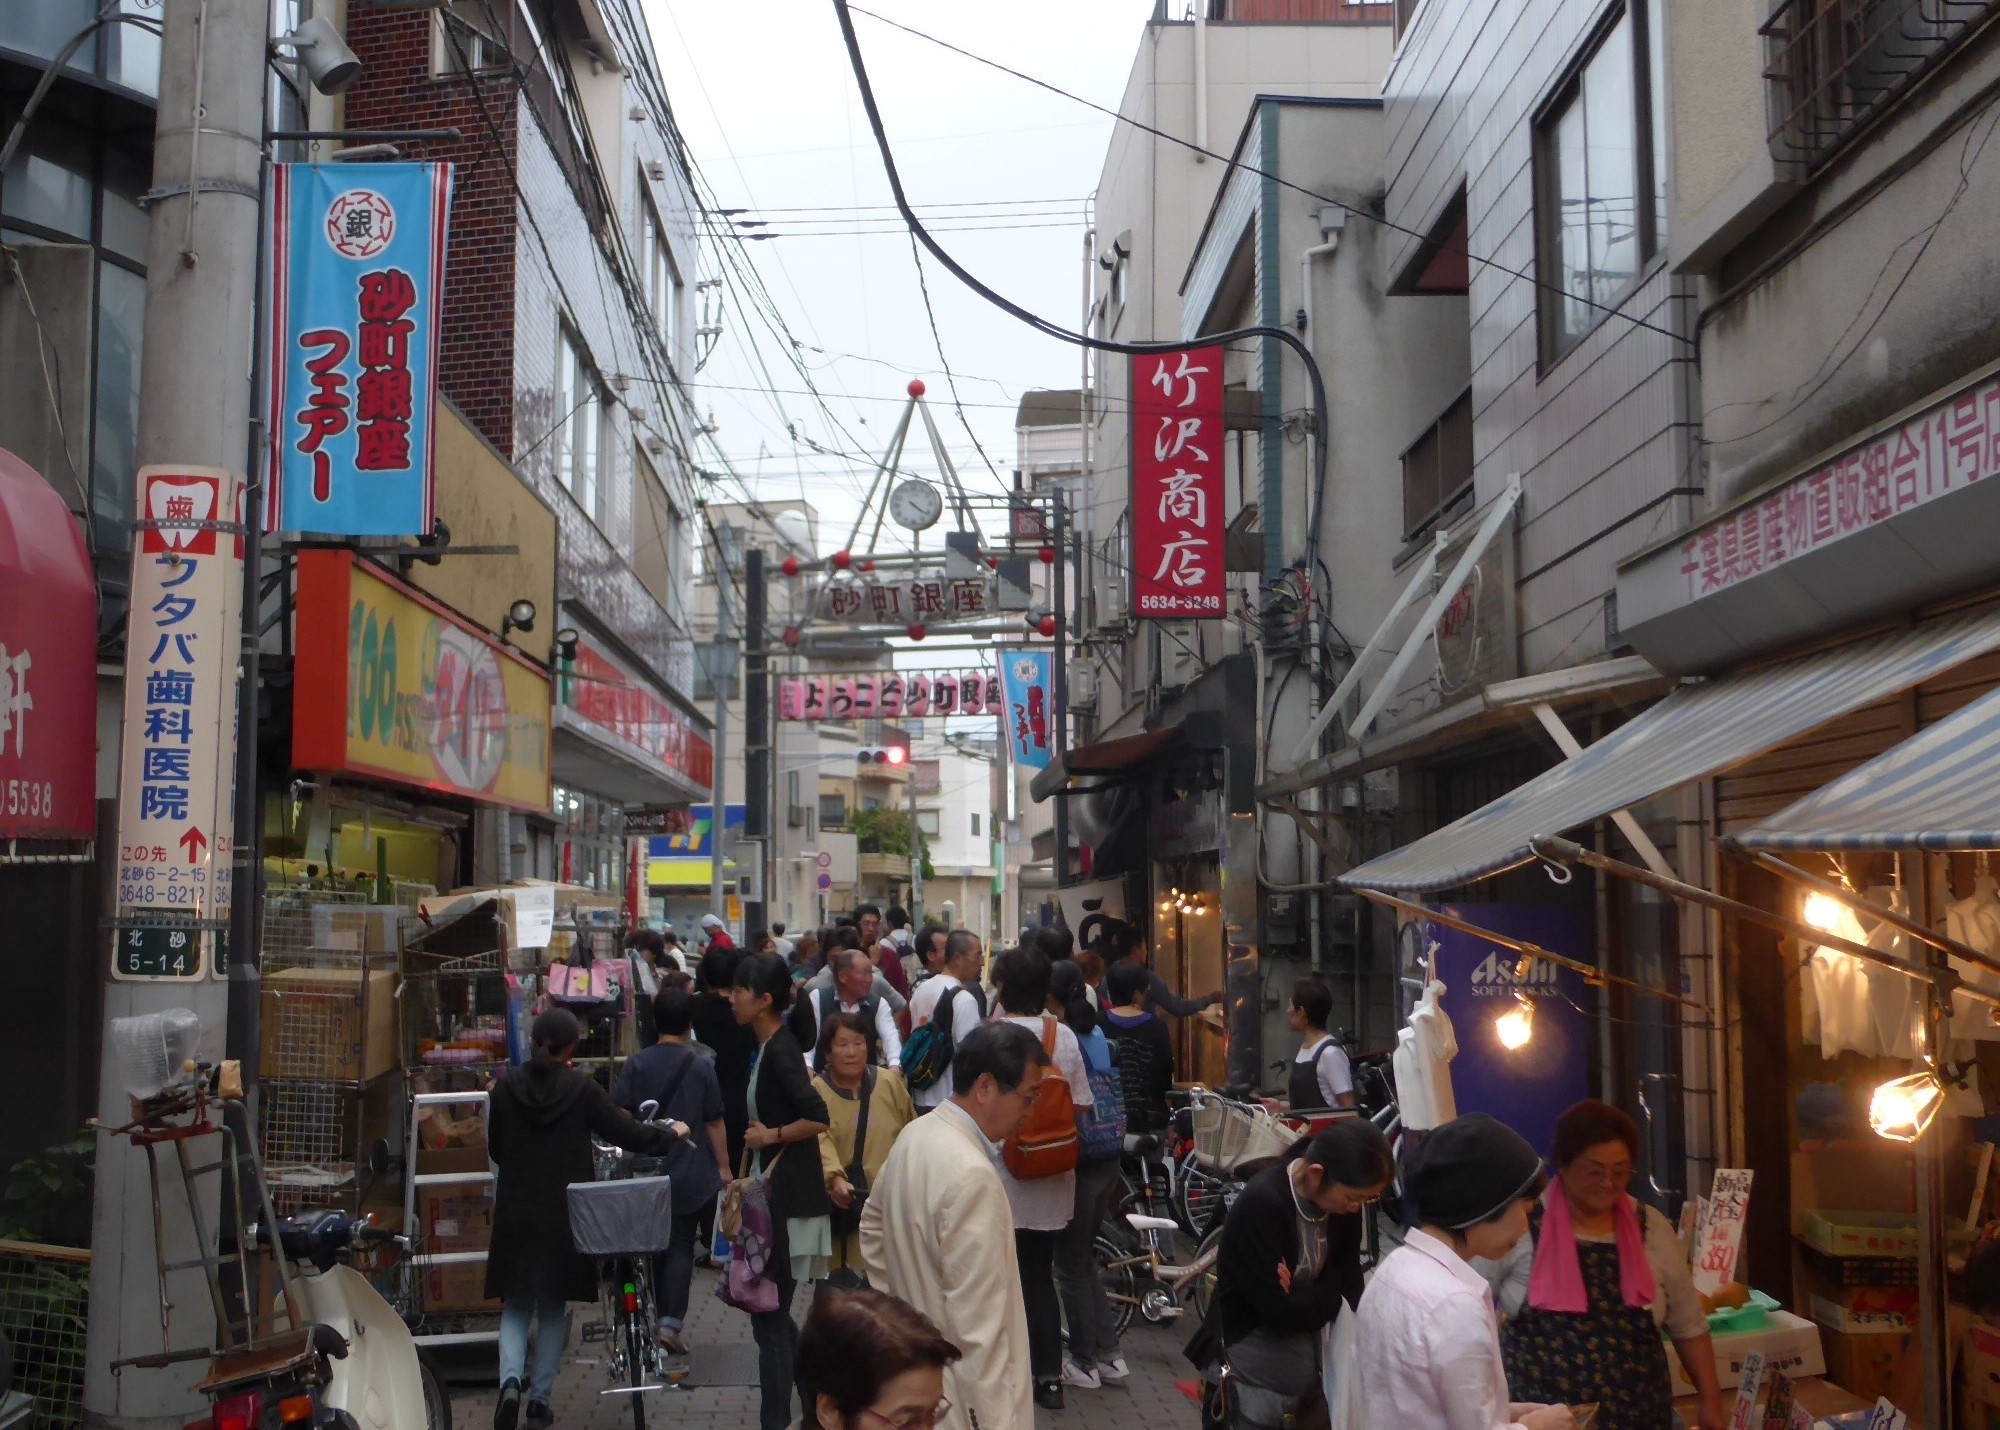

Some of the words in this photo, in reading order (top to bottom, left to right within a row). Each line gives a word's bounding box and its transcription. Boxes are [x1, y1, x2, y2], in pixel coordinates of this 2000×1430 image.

[345, 209, 372, 238] 銀
[355, 269, 415, 470] 砂町銀座
[297, 330, 350, 502] フェアー
[1151, 353, 1209, 587] 竹沢商店
[166, 495, 194, 521] 歯
[831, 580, 987, 617] 砂町銀座
[1141, 595, 1220, 609] 5634-3248
[140, 553, 198, 822] フタバ歯科医院
[121, 845, 167, 862] この先
[121, 866, 206, 882] 北砂6-2-15
[120, 885, 205, 903] 3648-8212
[128, 929, 187, 948] 北砂
[129, 953, 185, 972] 5-14
[1471, 985, 1507, 997] SOFT
